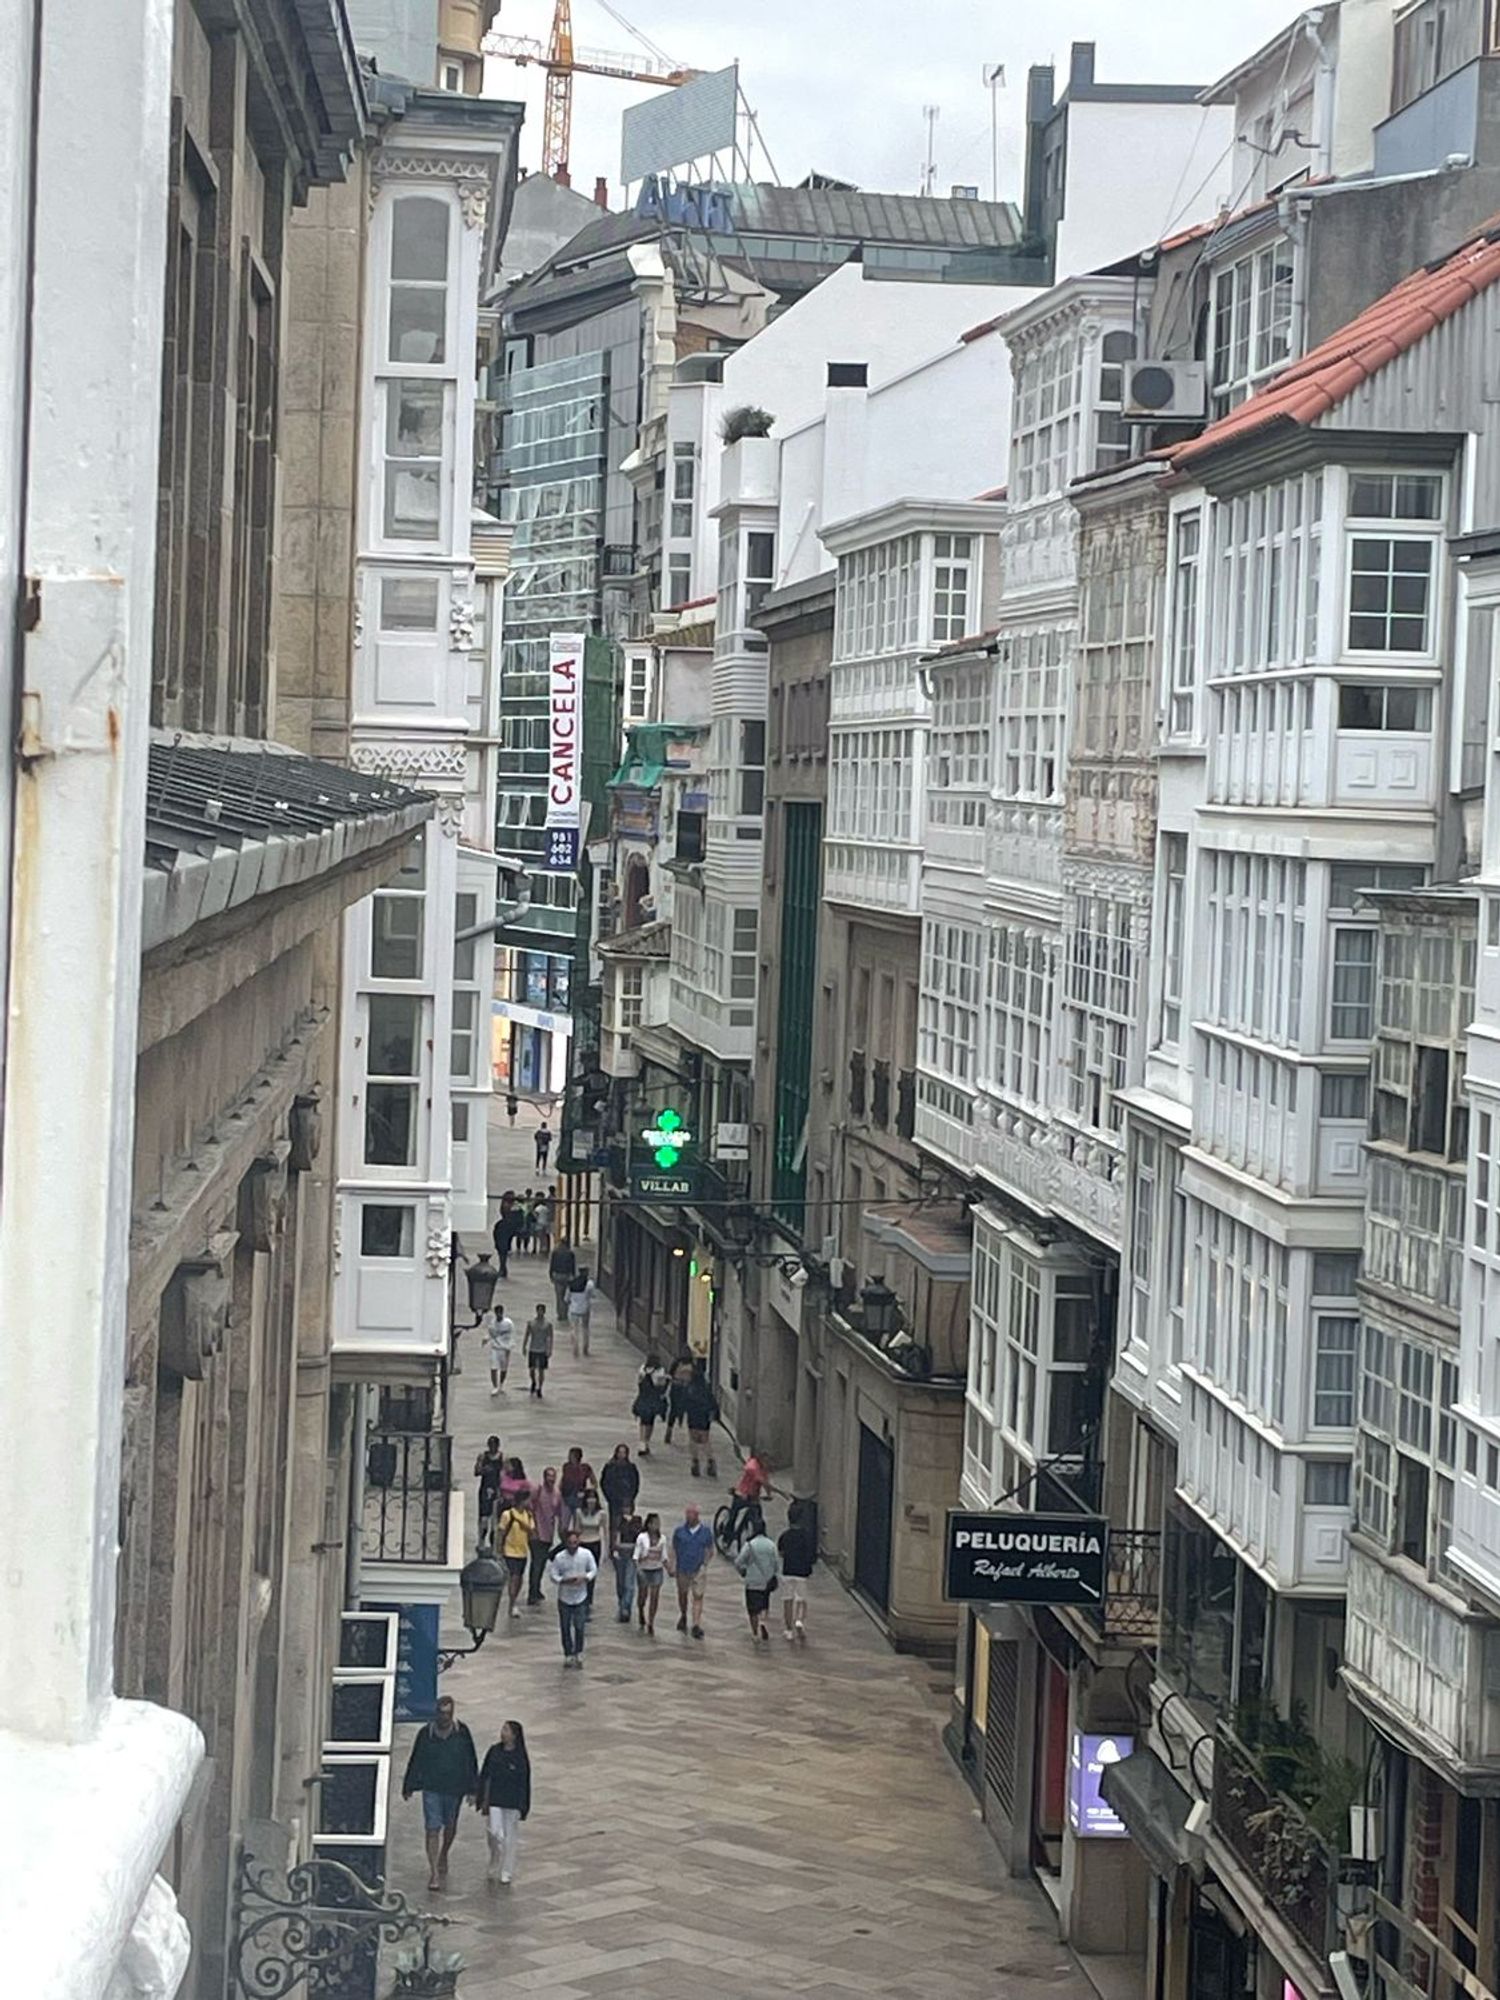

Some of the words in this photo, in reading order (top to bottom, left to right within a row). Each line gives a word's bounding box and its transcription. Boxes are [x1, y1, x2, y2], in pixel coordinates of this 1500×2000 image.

[552, 659, 575, 804] CANCELA
[552, 832, 572, 842] 981
[956, 1531, 1100, 1553] PELUQUERÍA
[973, 1559, 1025, 1581] Rafael
[1027, 1562, 1080, 1578] Alberto
